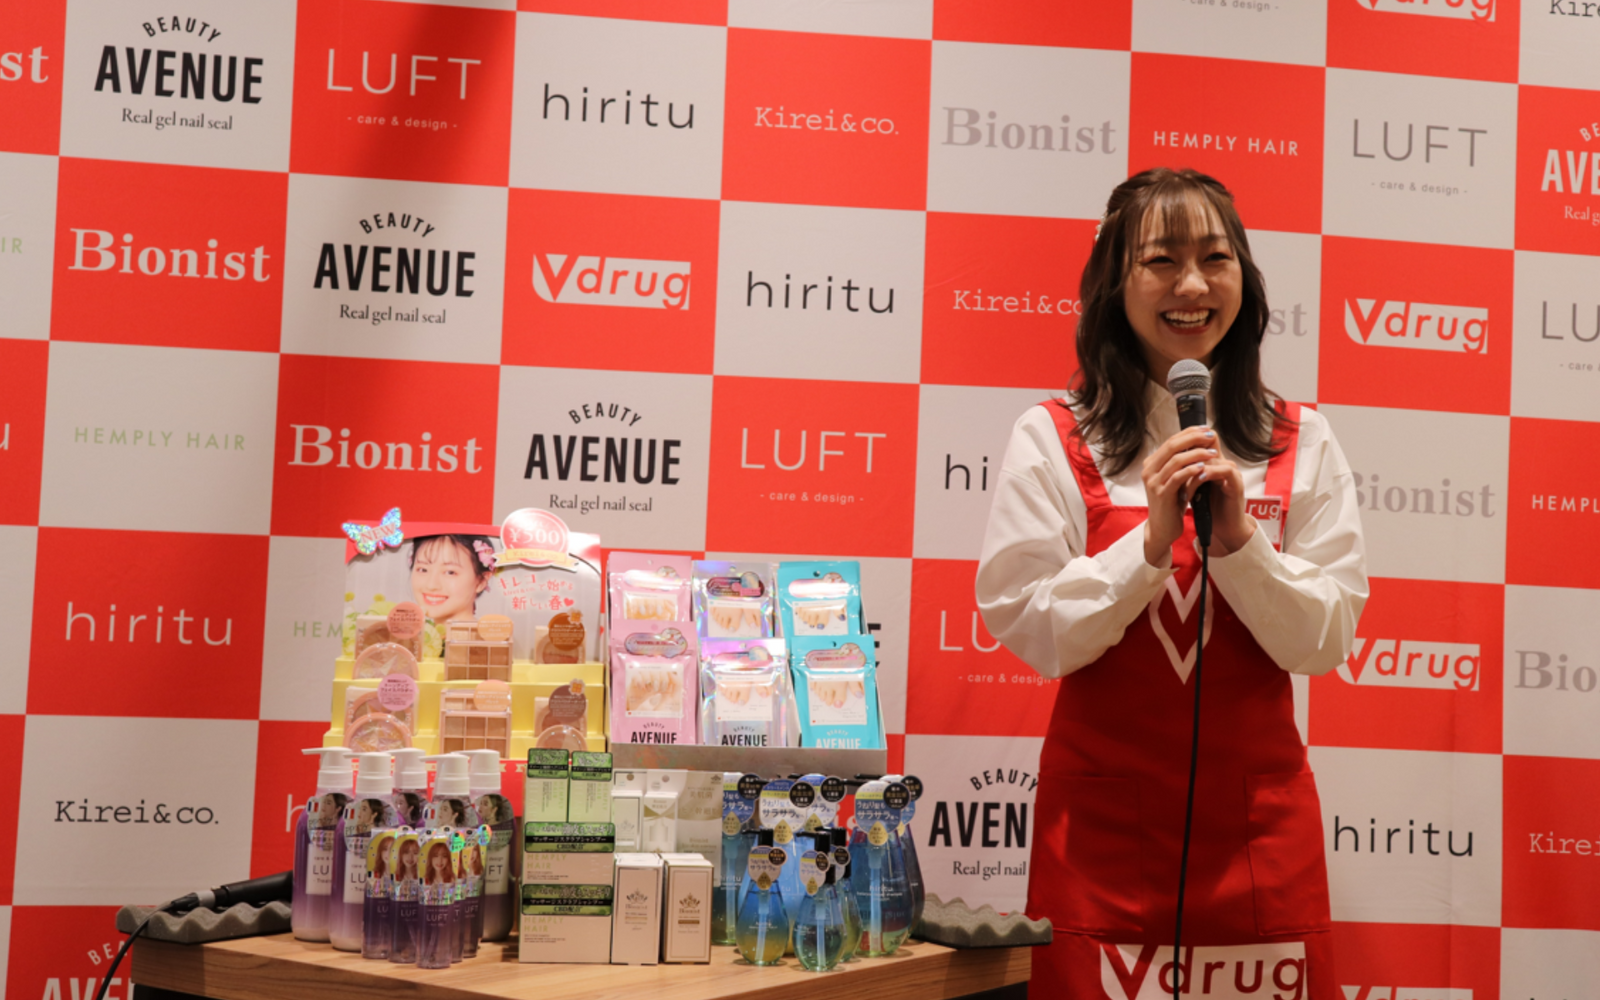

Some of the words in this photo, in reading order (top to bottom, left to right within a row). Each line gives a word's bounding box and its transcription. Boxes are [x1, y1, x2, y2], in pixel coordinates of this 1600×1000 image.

[1232, 0, 1270, 13] design
[143, 16, 221, 42] BEAUTY
[94, 45, 264, 104] AVENUE
[327, 49, 481, 99] LUFT
[543, 83, 693, 128] hiritu
[123, 108, 152, 123] Real
[156, 111, 176, 130] gel
[180, 114, 204, 127] nail
[208, 116, 232, 130] seal
[357, 116, 385, 124] care
[391, 117, 398, 125] &
[405, 118, 447, 131] design
[755, 106, 898, 134] Kirei&co.
[943, 108, 1116, 154] Bionist
[1154, 131, 1236, 150] HEMPLY
[1249, 138, 1297, 155] HAIR
[1353, 119, 1487, 167] LUFT
[1380, 182, 1404, 190] care
[1410, 182, 1416, 191] &
[1422, 184, 1458, 196] design
[360, 212, 434, 237] BEAUTY
[1565, 206, 1589, 219] Real
[69, 228, 269, 281] Bionist
[314, 243, 475, 297] AVENUE
[533, 253, 692, 311] Vdrug
[747, 271, 893, 313] hiritu
[340, 304, 369, 319] Real
[372, 306, 391, 325] gel
[395, 308, 418, 321] nail
[422, 309, 445, 323] seal
[1344, 298, 1489, 355] Vdrug
[1569, 363, 1593, 371] care
[569, 402, 641, 426] BEAUTY
[75, 427, 172, 447] HEMPLY
[187, 433, 244, 450] HAIR
[289, 425, 482, 473] Bionist
[741, 428, 886, 472] LUFT
[524, 434, 681, 485] AVENUE
[549, 494, 578, 510] Real
[581, 495, 599, 515] gel
[603, 496, 626, 510] nail
[629, 497, 652, 511] seal
[770, 493, 796, 501] care
[801, 492, 808, 501] &
[814, 493, 854, 505] design
[360, 523, 397, 544] NEW
[66, 602, 231, 645] hiritu
[965, 673, 996, 684] care
[998, 673, 1006, 683] &
[643, 722, 665, 730] BEAUTY
[721, 734, 768, 747] AVENUE
[970, 768, 1038, 792] BEAUTY
[55, 799, 218, 824] Kirei&co.
[1335, 816, 1472, 856] hiritu
[526, 853, 567, 862] HEMPLY
[526, 862, 552, 870] HAIR
[953, 861, 980, 876] Real
[982, 861, 1001, 881] gel
[1004, 861, 1026, 876] nail
[426, 913, 448, 921] LUFT
[524, 916, 564, 924] HEMPLY
[524, 925, 549, 933] HAIR
